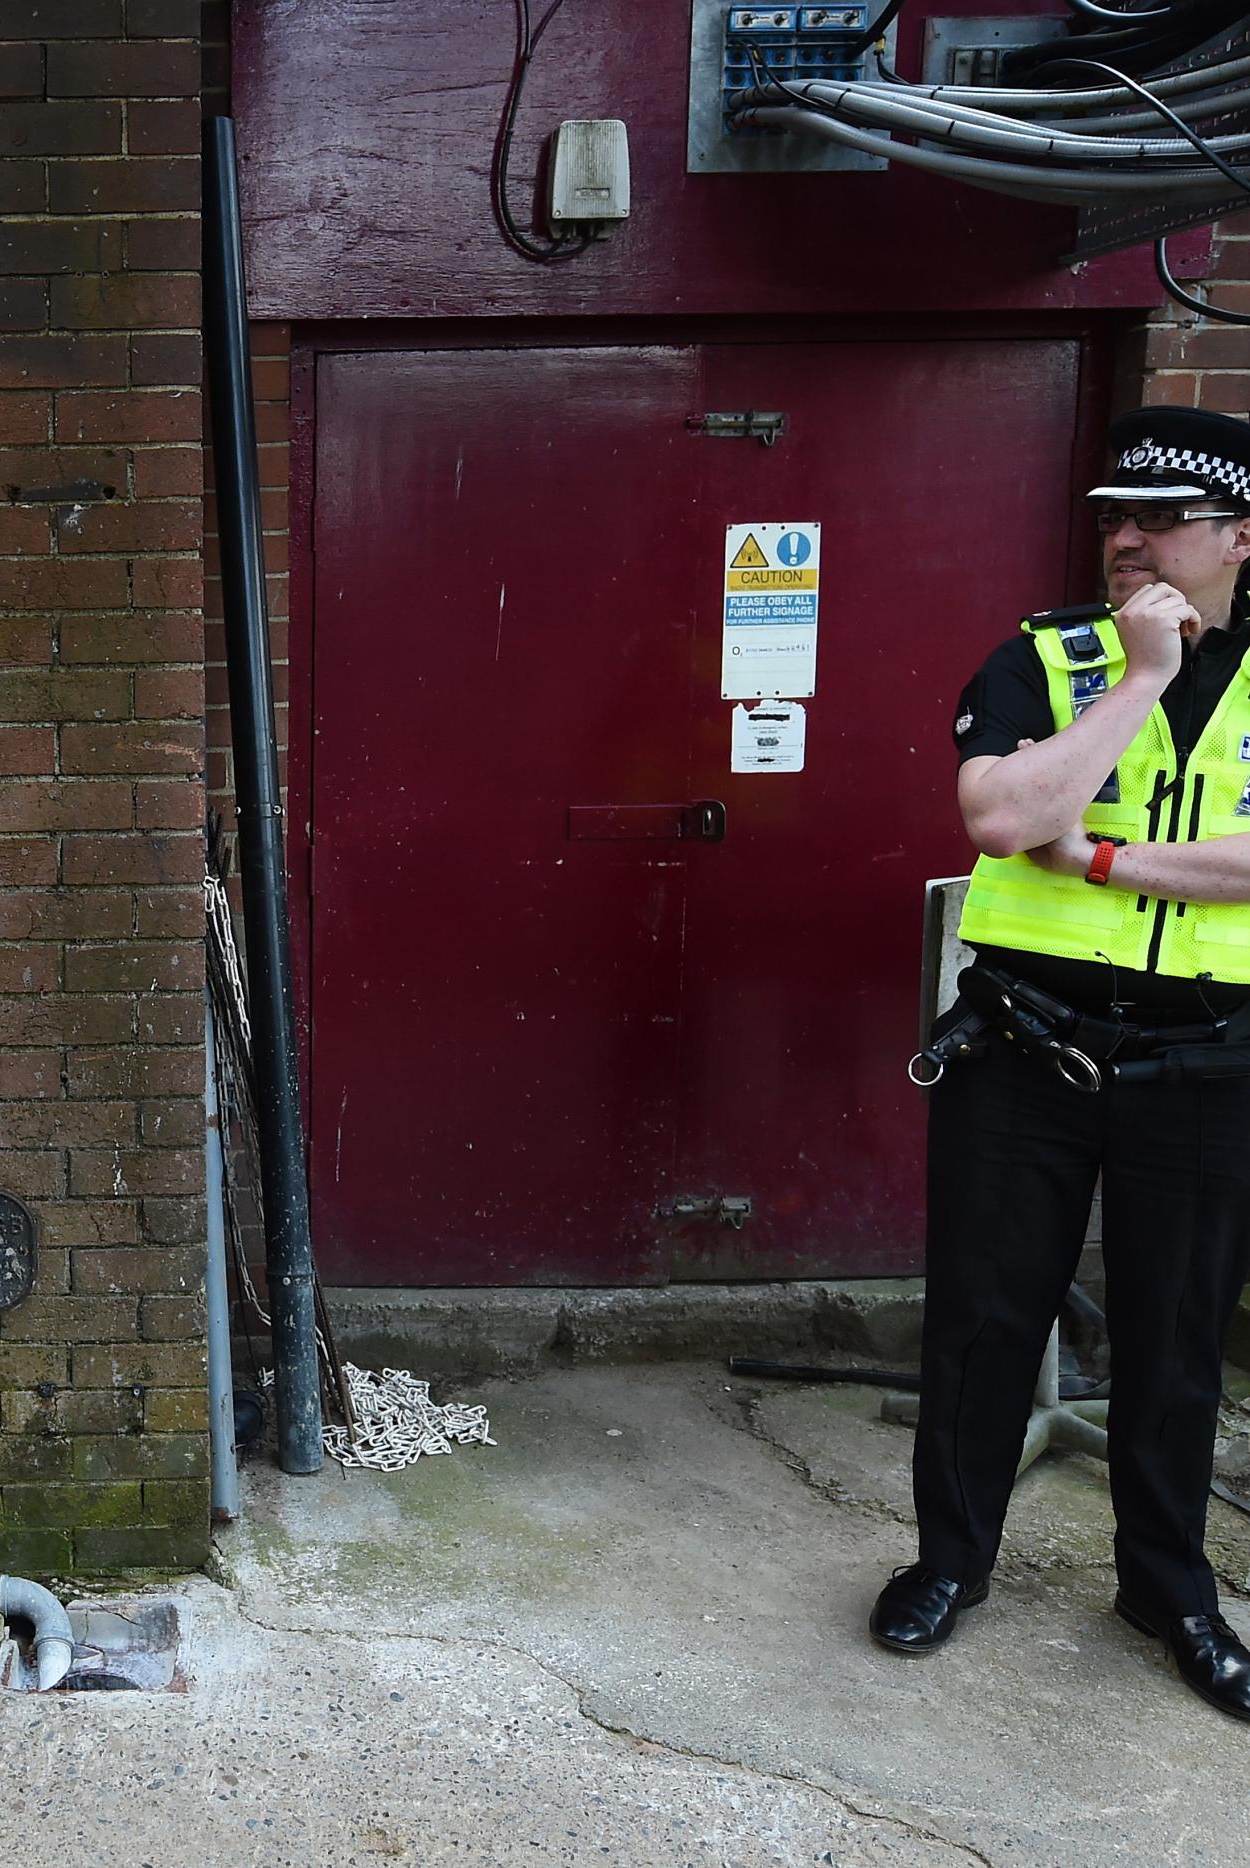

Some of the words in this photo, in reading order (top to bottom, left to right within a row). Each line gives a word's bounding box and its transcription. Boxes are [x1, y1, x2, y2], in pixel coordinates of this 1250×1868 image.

[741, 570, 803, 584] CAUTION
[730, 597, 766, 607] PLEASE
[767, 596, 792, 606] OBEY
[794, 596, 812, 605] ALL
[728, 607, 770, 617] FURTHER
[772, 606, 814, 616] SIGNAGE
